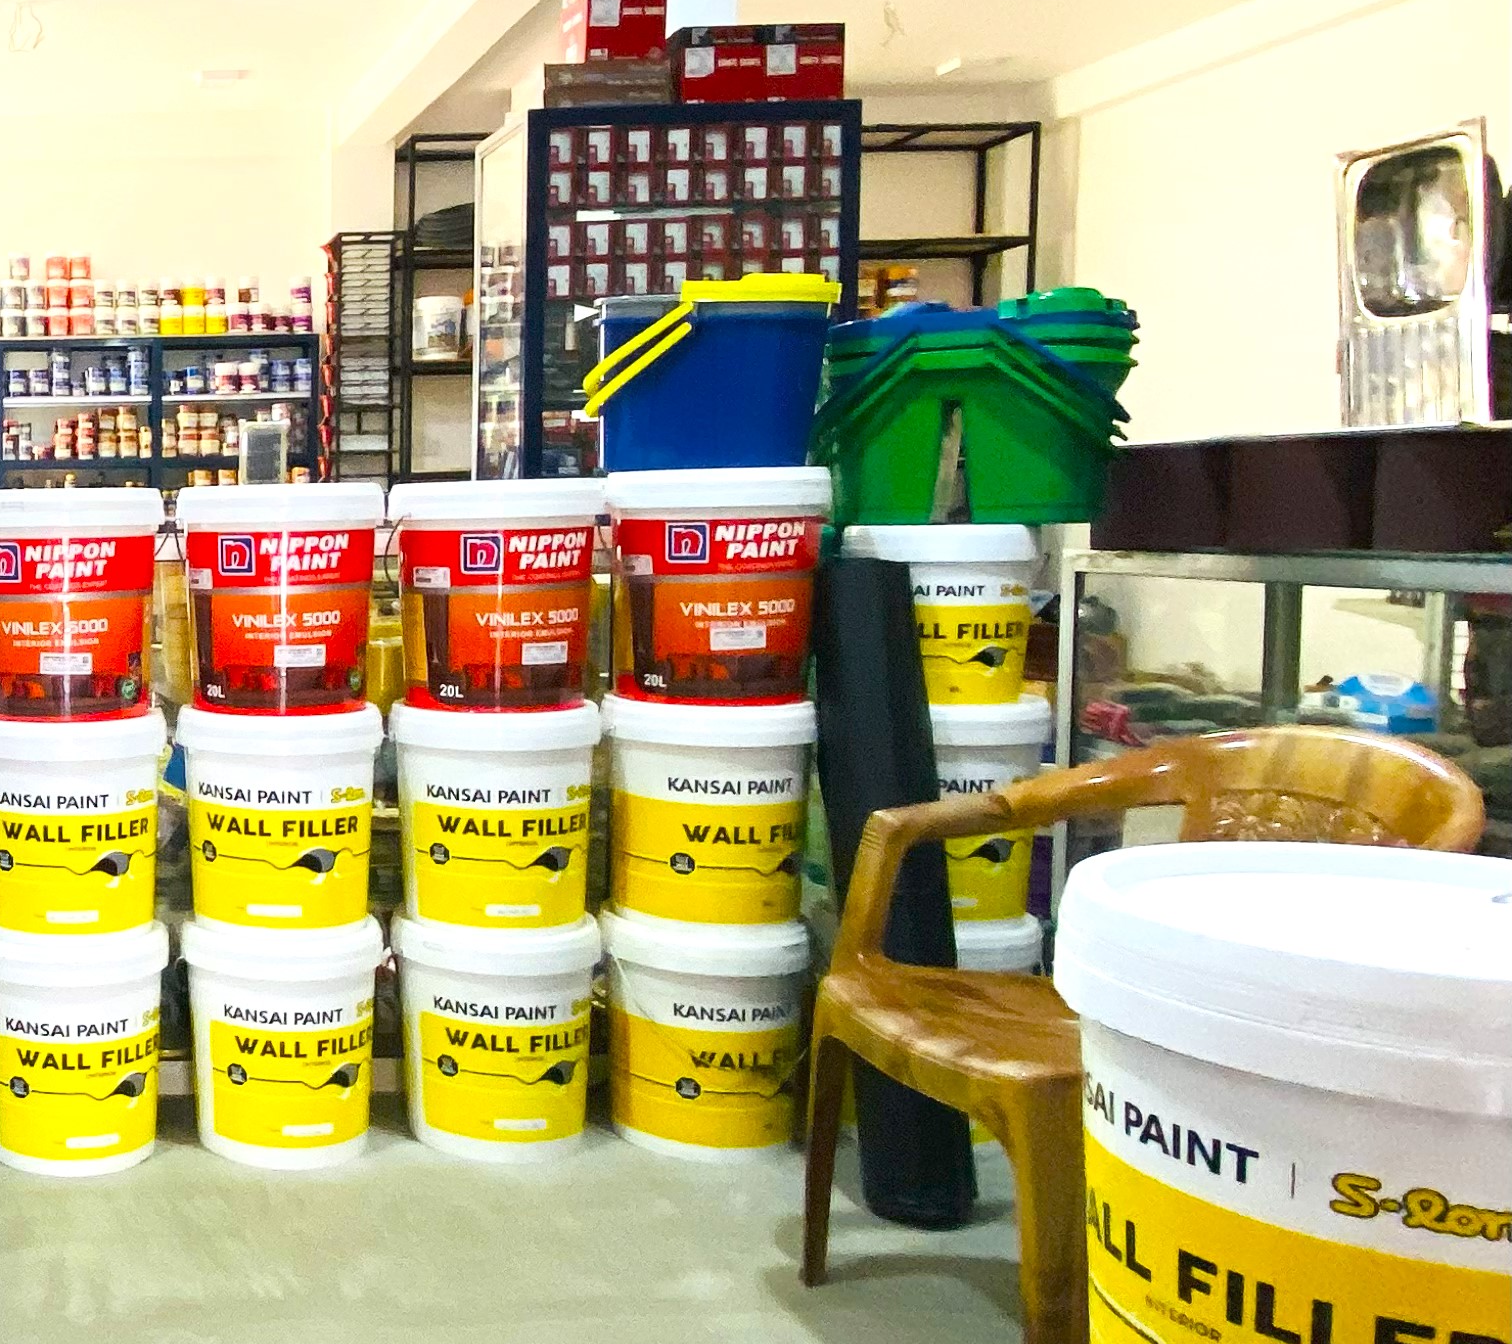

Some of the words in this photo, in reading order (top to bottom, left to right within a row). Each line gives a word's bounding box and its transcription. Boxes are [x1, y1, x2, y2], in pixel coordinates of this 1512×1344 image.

[715, 522, 805, 541] NIPPON
[25, 541, 116, 562] NIPPON
[508, 532, 587, 553] NIPPON
[726, 539, 799, 560] PAINT
[35, 559, 108, 580] PAINT
[271, 552, 341, 572] PAINT
[519, 549, 581, 569] PAINT
[936, 585, 986, 597] PAINT
[475, 612, 544, 626] VINILEX
[548, 608, 579, 624] 5000
[679, 602, 752, 617] VINILEX
[758, 599, 795, 615] 5000
[2, 621, 63, 636] VINILEX
[68, 618, 108, 634] 5000
[232, 613, 297, 628] VINILEX
[302, 610, 340, 626] 5000
[917, 622, 947, 639] LL
[957, 621, 1025, 639] FILLER
[207, 684, 225, 698] 20L
[439, 684, 464, 698] 20L
[643, 674, 667, 688] 20L
[198, 781, 251, 803] KANSAI
[258, 789, 312, 805] PAINT
[427, 783, 491, 803] KANSAI
[498, 789, 551, 804] PAINT
[667, 776, 741, 795] KANSAI
[748, 777, 793, 795] PAINT
[938, 778, 995, 793] PAINT
[57, 794, 109, 810] PAINT
[2, 820, 71, 843] WALL
[81, 817, 149, 843] FILLER
[206, 812, 272, 837] WALL
[282, 816, 359, 838] FILLER
[437, 814, 512, 837] WALL
[522, 813, 587, 837] FILLER
[682, 823, 761, 845] WALL
[769, 823, 796, 843] FIL
[223, 1004, 287, 1025] KANSAI
[294, 1008, 343, 1025] PAINT
[433, 996, 498, 1020] KANSAI
[505, 1005, 558, 1020] PAINT
[673, 1003, 746, 1022] KANSAI
[5, 1016, 70, 1037] KANSAI
[77, 1018, 129, 1037] PAINT
[235, 1035, 307, 1058] WALL
[445, 1027, 519, 1053] WALL
[16, 1048, 91, 1070] WALL
[689, 1049, 769, 1071] WALL
[1085, 1072, 1115, 1126] SAI
[1124, 1101, 1259, 1185] PAINT
[1087, 1187, 1152, 1283] ALL
[1144, 1294, 1223, 1344] INTERIOR
